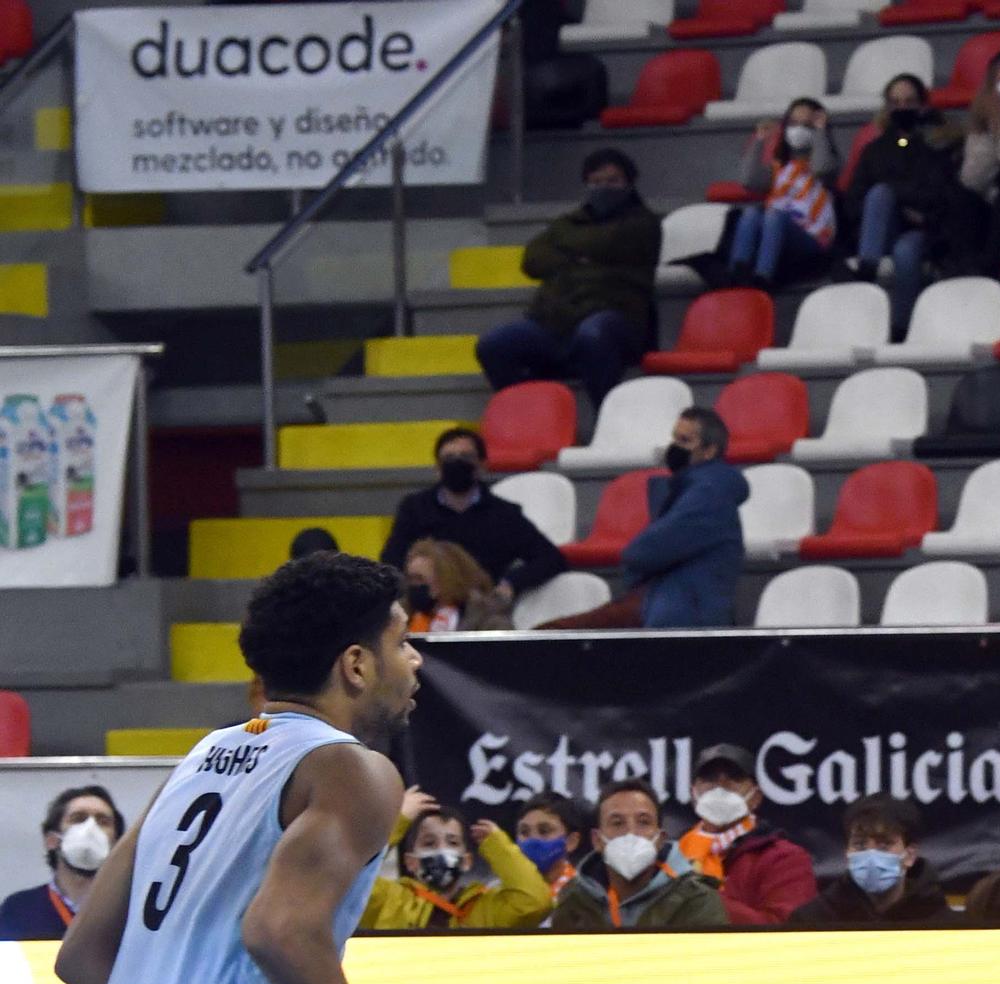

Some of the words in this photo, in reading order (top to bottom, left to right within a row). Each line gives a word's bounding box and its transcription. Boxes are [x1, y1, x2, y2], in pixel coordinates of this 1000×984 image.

[131, 13, 428, 80] duacode.
[133, 110, 259, 139] software
[268, 116, 286, 140] y
[132, 146, 278, 174] mezclado,
[286, 149, 323, 171] no
[461, 731, 693, 805] Estrell
[142, 792, 223, 932] 3
